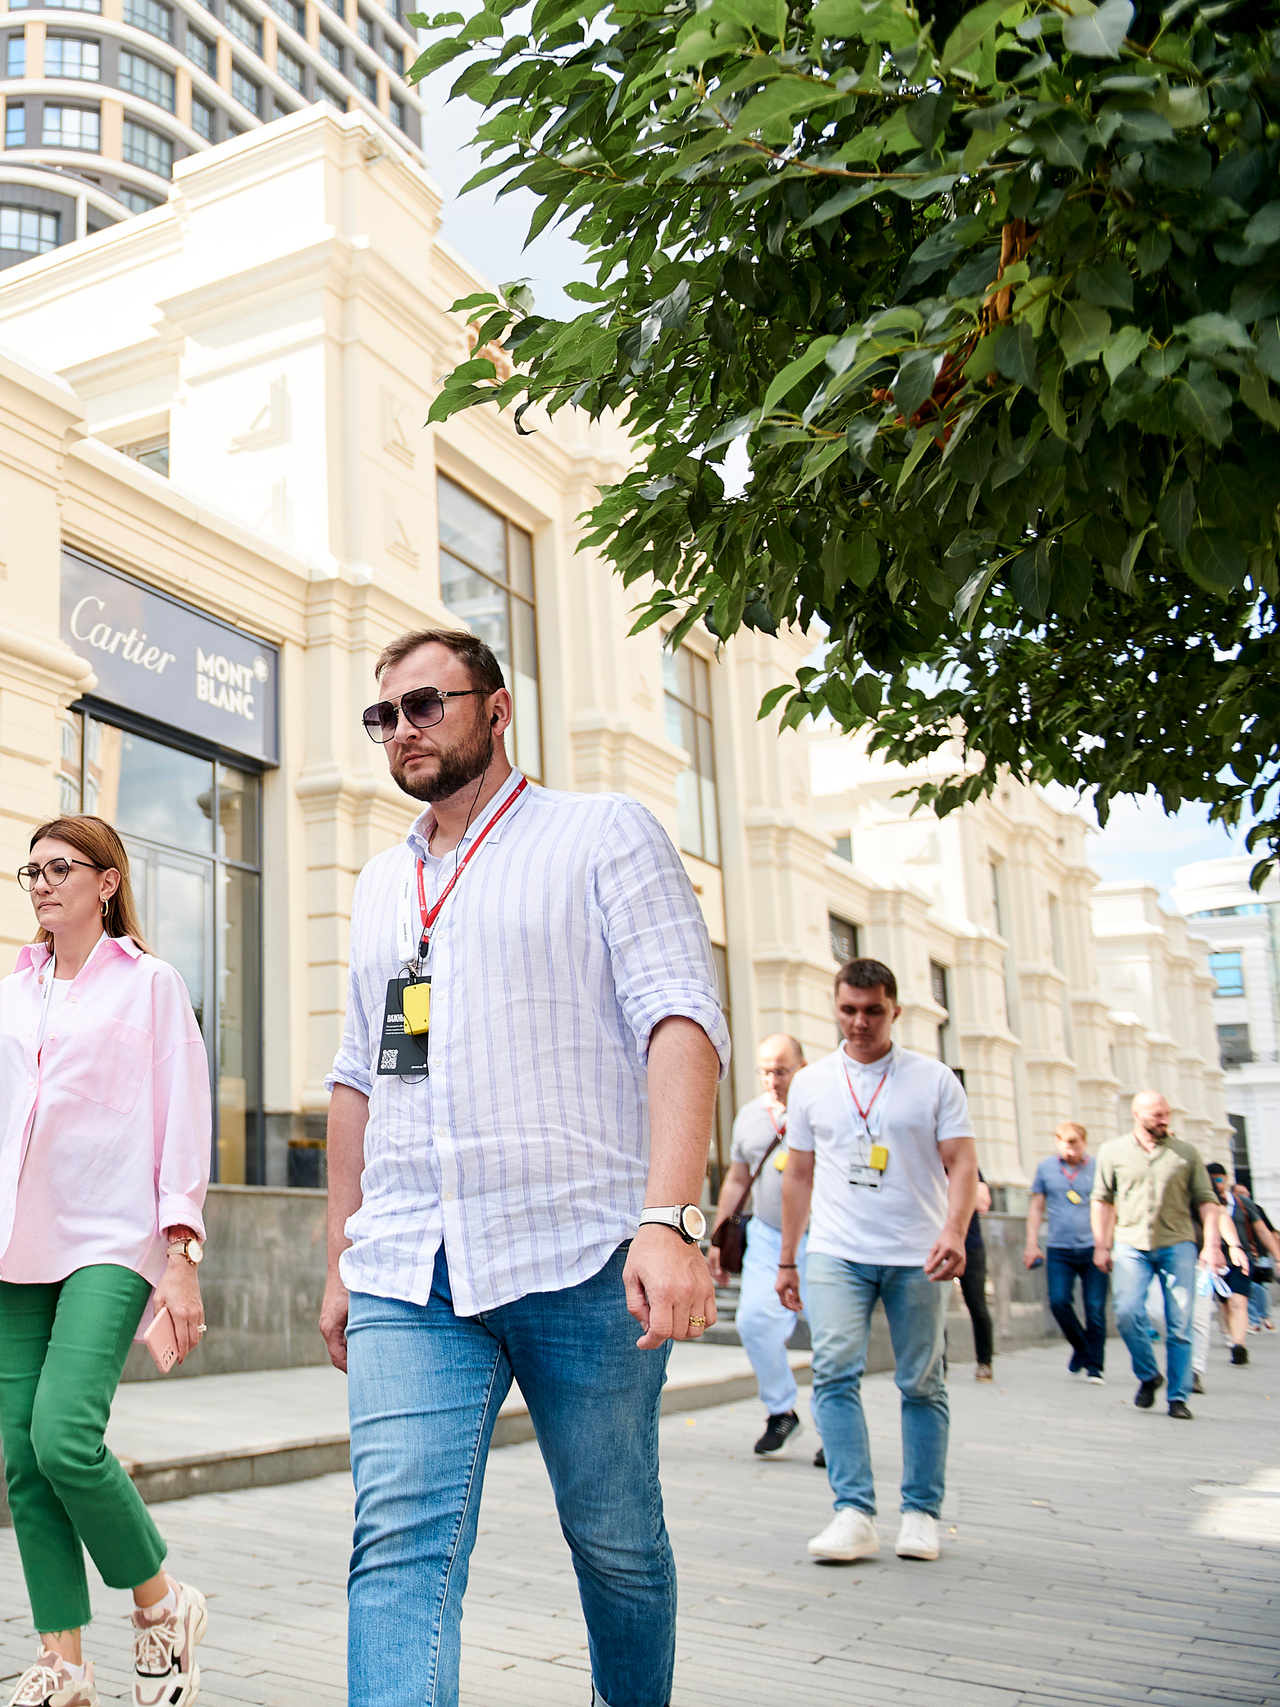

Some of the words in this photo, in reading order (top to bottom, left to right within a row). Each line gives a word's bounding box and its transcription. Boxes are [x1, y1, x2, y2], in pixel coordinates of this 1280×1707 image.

[70, 595, 176, 674] Cartier
[196, 646, 255, 693] MONT
[196, 672, 255, 721] BLANC
